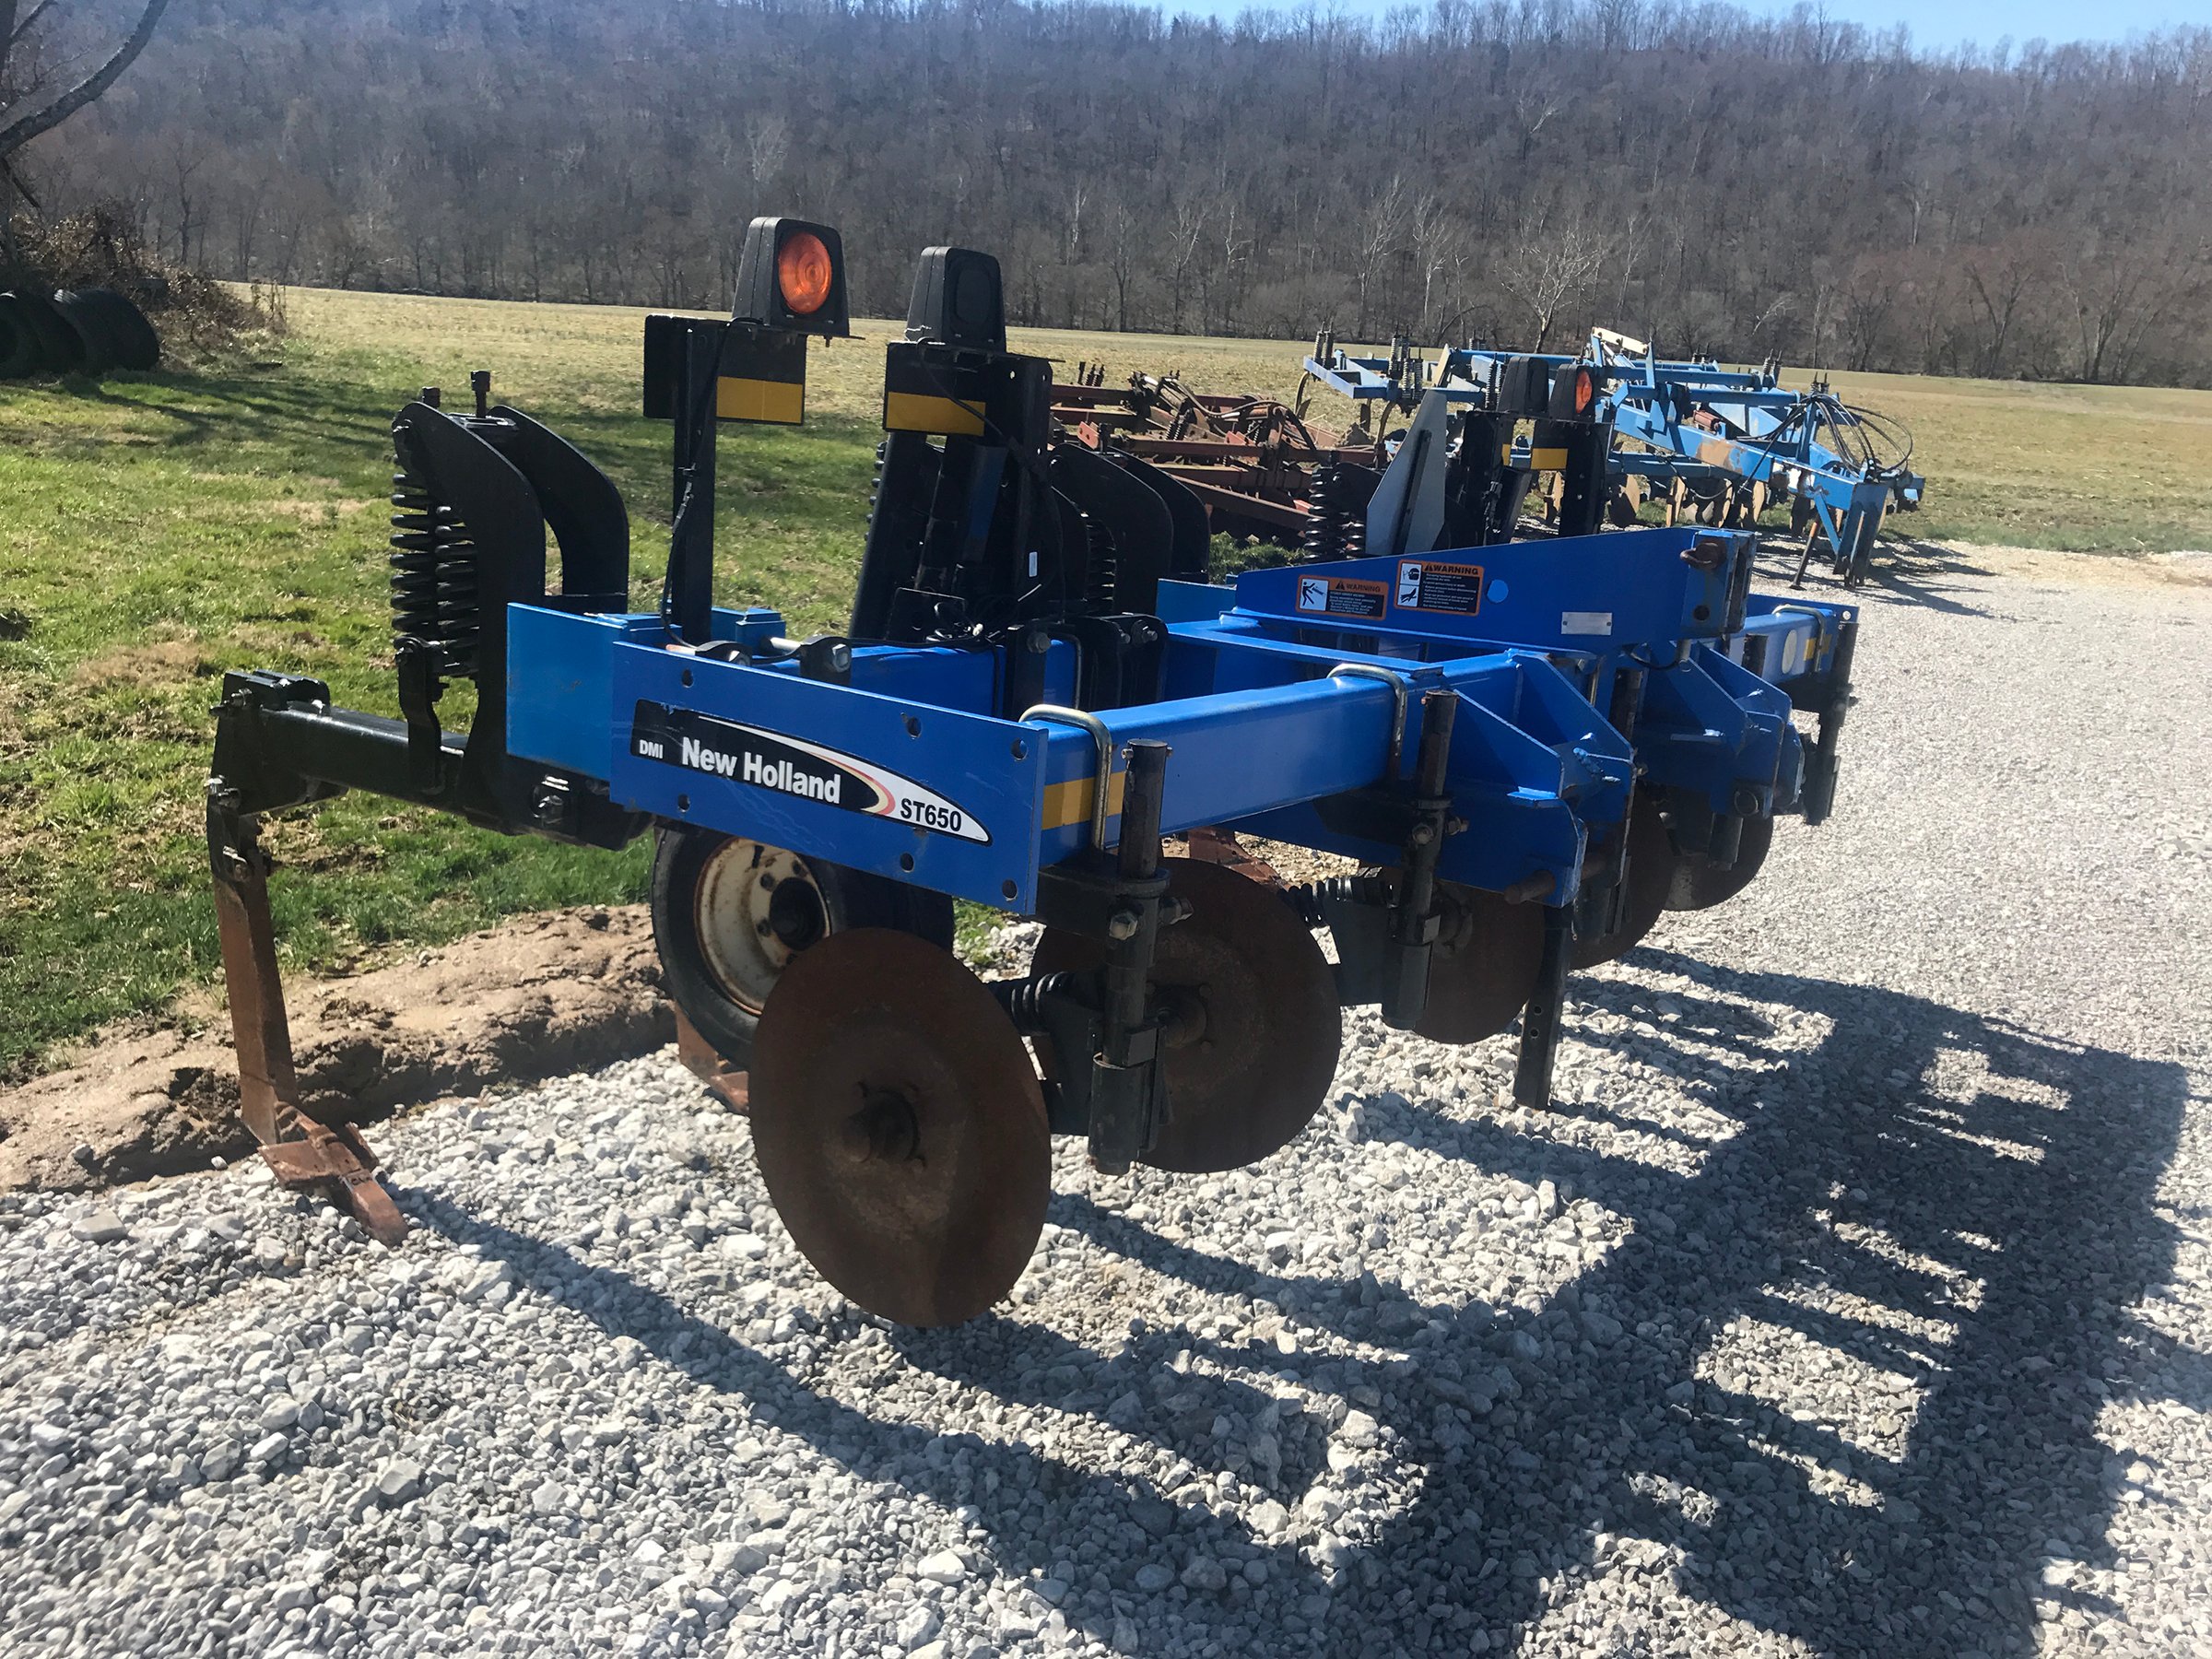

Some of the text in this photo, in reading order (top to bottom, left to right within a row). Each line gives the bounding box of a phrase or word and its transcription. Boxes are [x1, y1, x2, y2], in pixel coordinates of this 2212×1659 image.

[1433, 565, 1478, 575] WARNING
[1347, 582, 1381, 593] WARNING
[639, 739, 663, 759] DMI
[682, 736, 841, 804] New Holland
[900, 797, 961, 832] ST650
